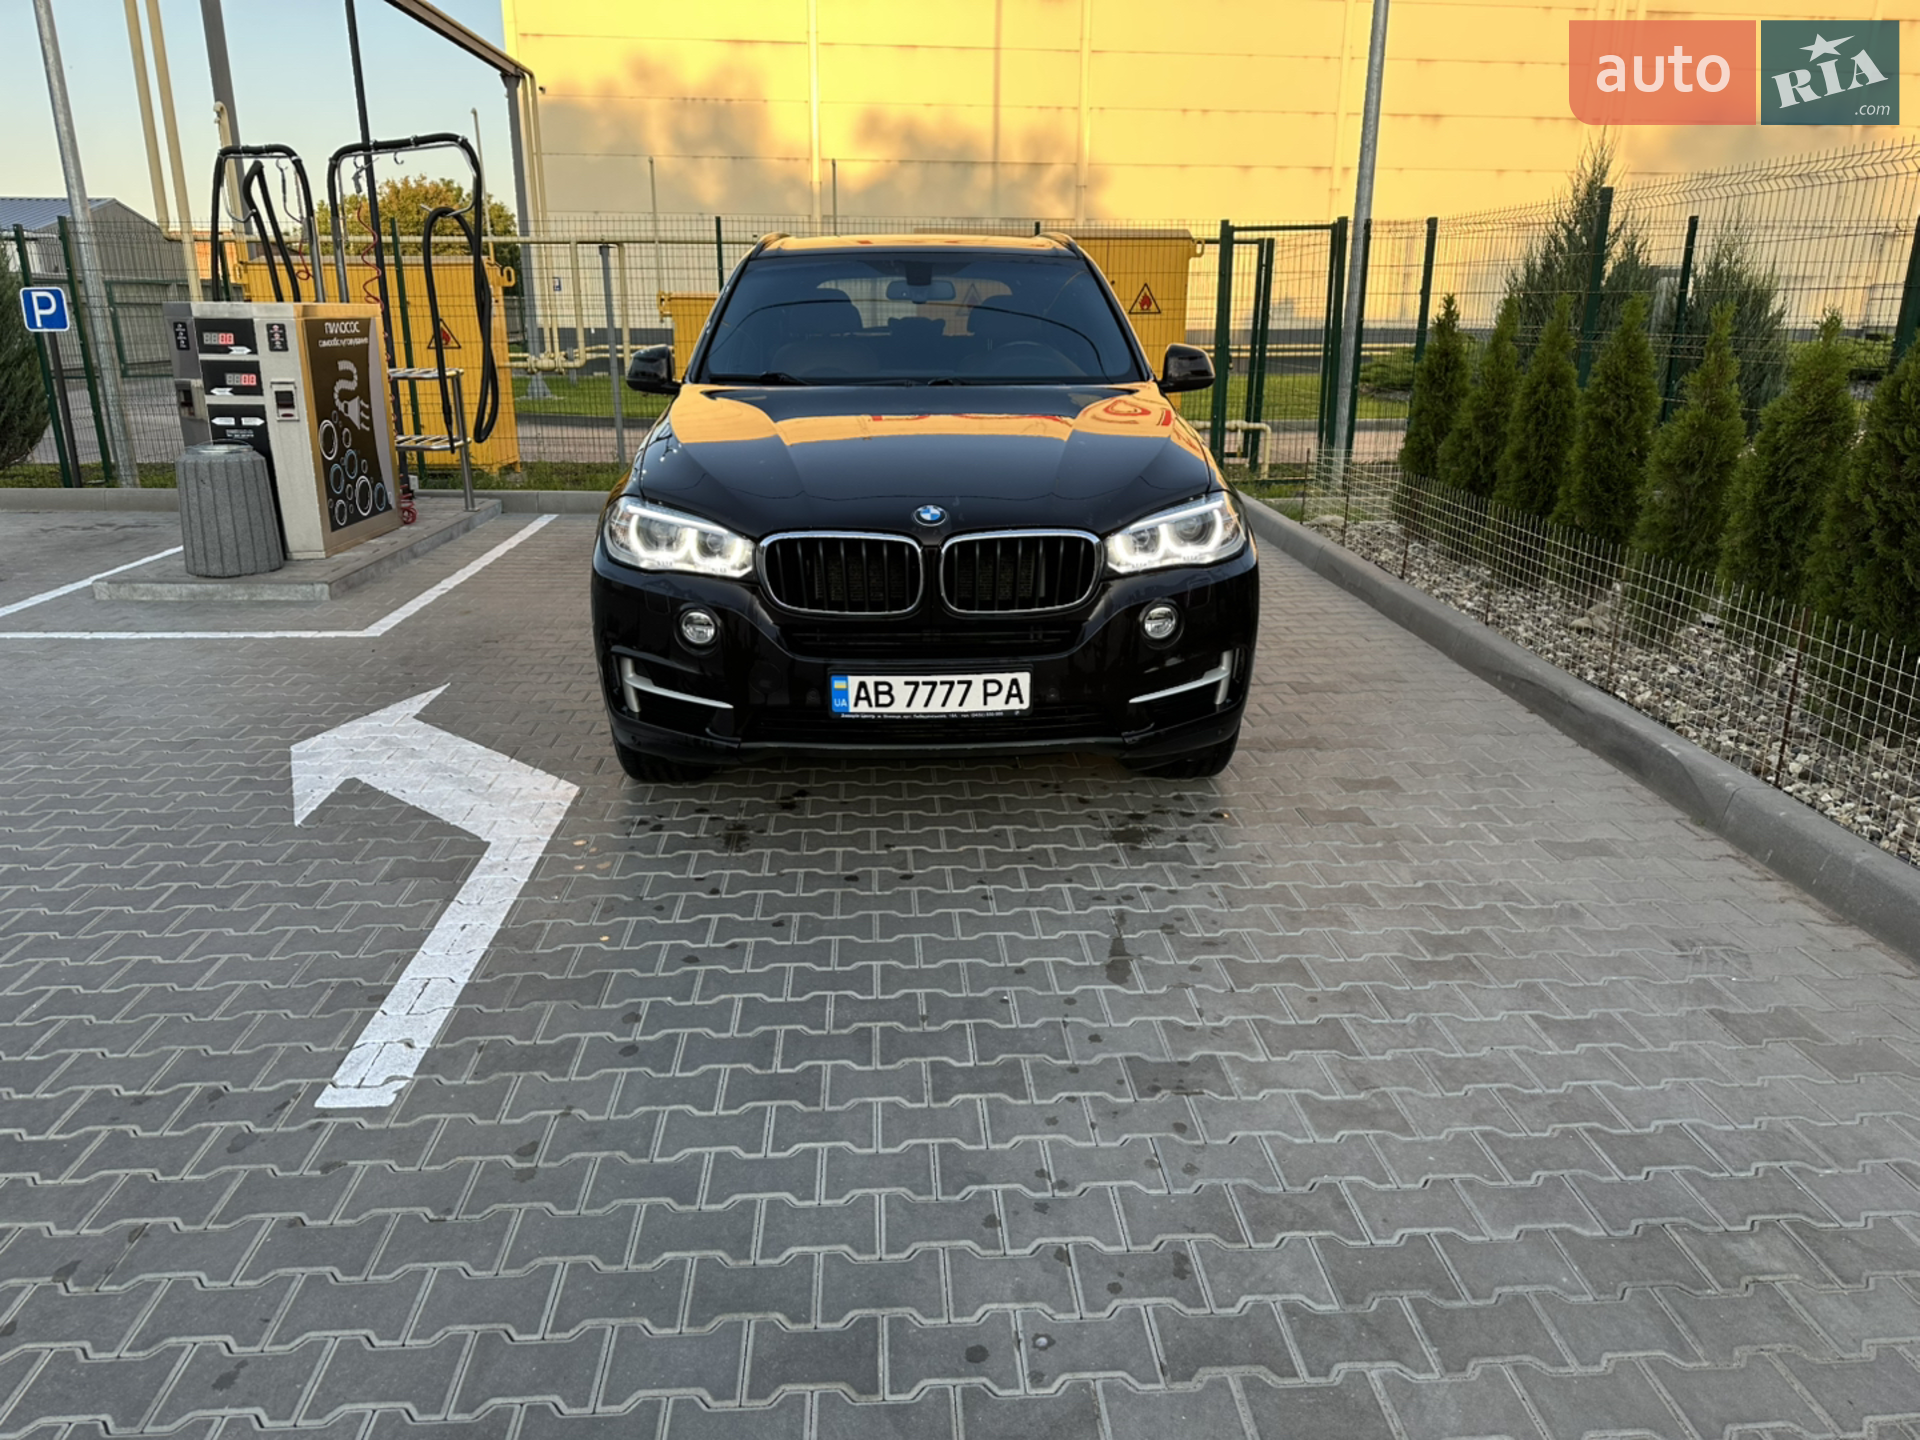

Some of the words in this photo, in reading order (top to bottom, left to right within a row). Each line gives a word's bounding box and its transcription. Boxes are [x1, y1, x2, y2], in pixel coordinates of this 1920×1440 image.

[31, 291, 57, 328] P
[324, 321, 361, 335] ПИЛОСОС
[833, 698, 848, 708] UA
[853, 680, 896, 708] AB
[903, 679, 973, 709] 7777
[982, 677, 1025, 707] PA
